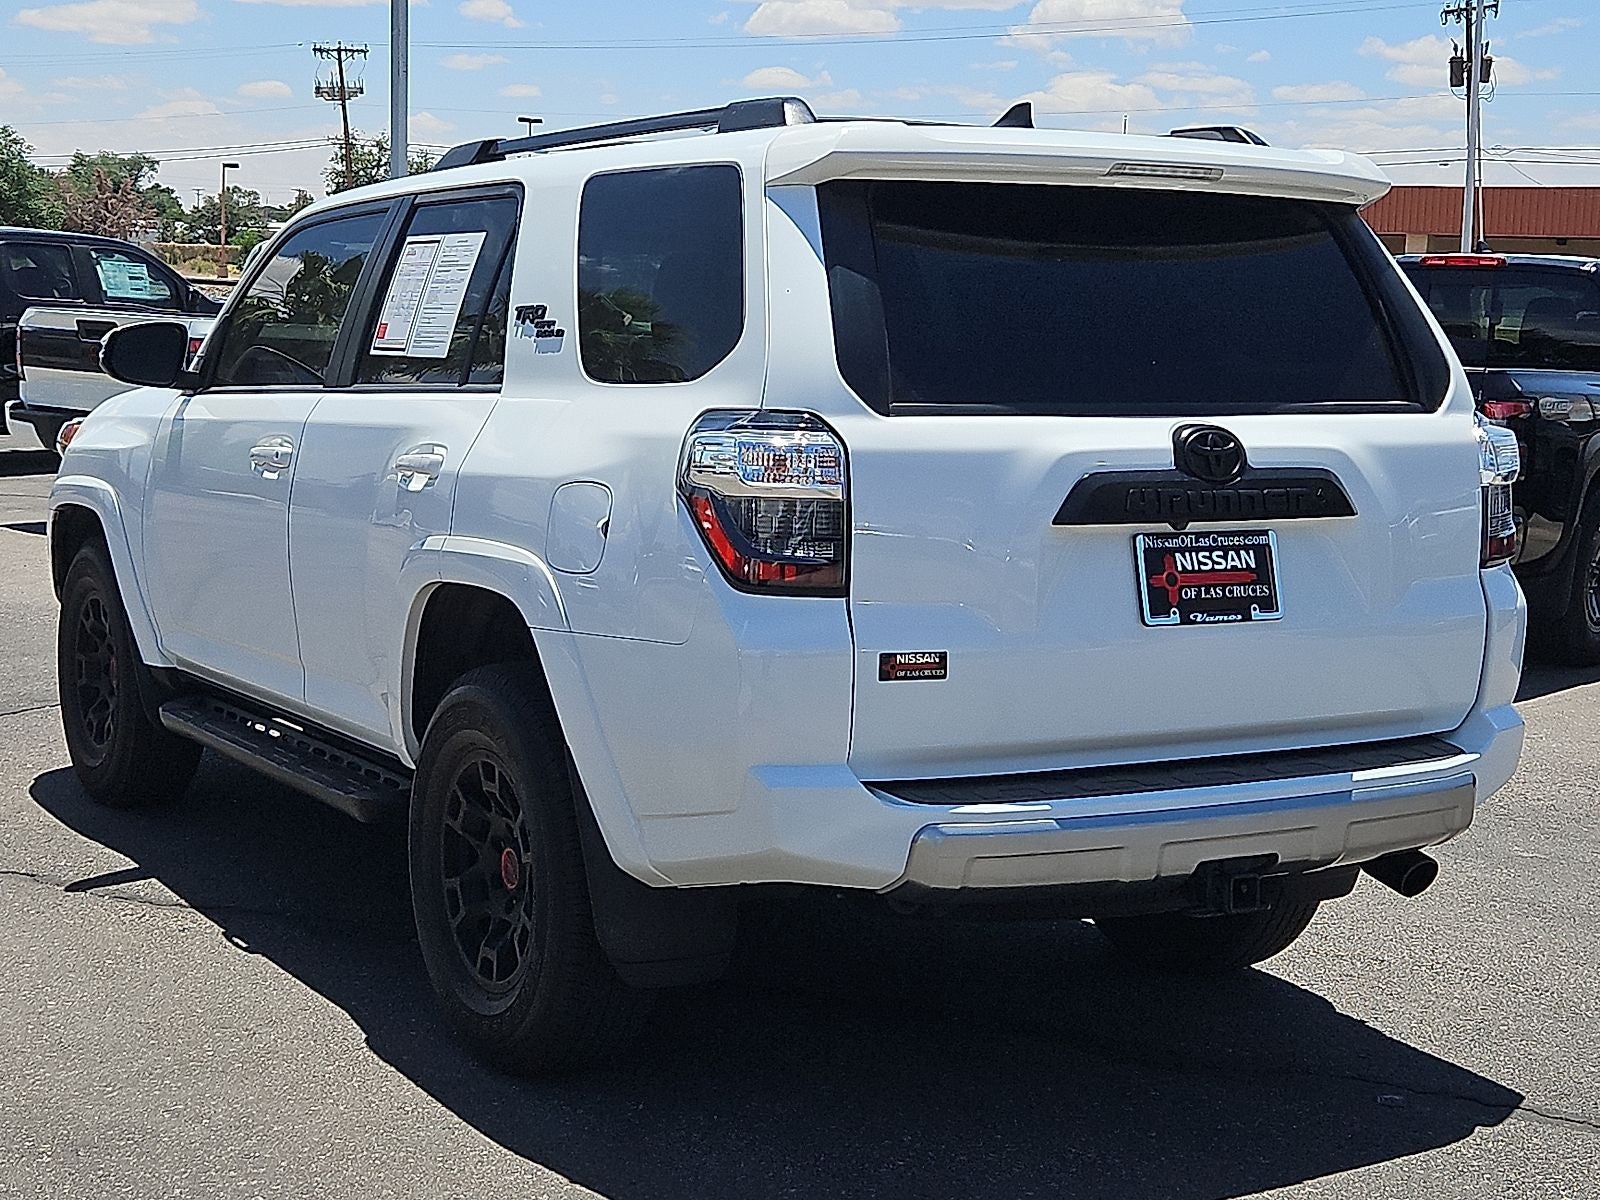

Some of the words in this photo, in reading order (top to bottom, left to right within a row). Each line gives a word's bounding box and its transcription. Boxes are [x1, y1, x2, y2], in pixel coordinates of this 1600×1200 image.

[515, 305, 547, 325] TRD
[1174, 550, 1256, 571] NISSAN
[1181, 587, 1199, 600] OF
[1201, 586, 1223, 599] LAS
[1226, 585, 1270, 598] CRUCES
[1190, 612, 1242, 622] Vamos
[896, 653, 940, 664] NISSAN
